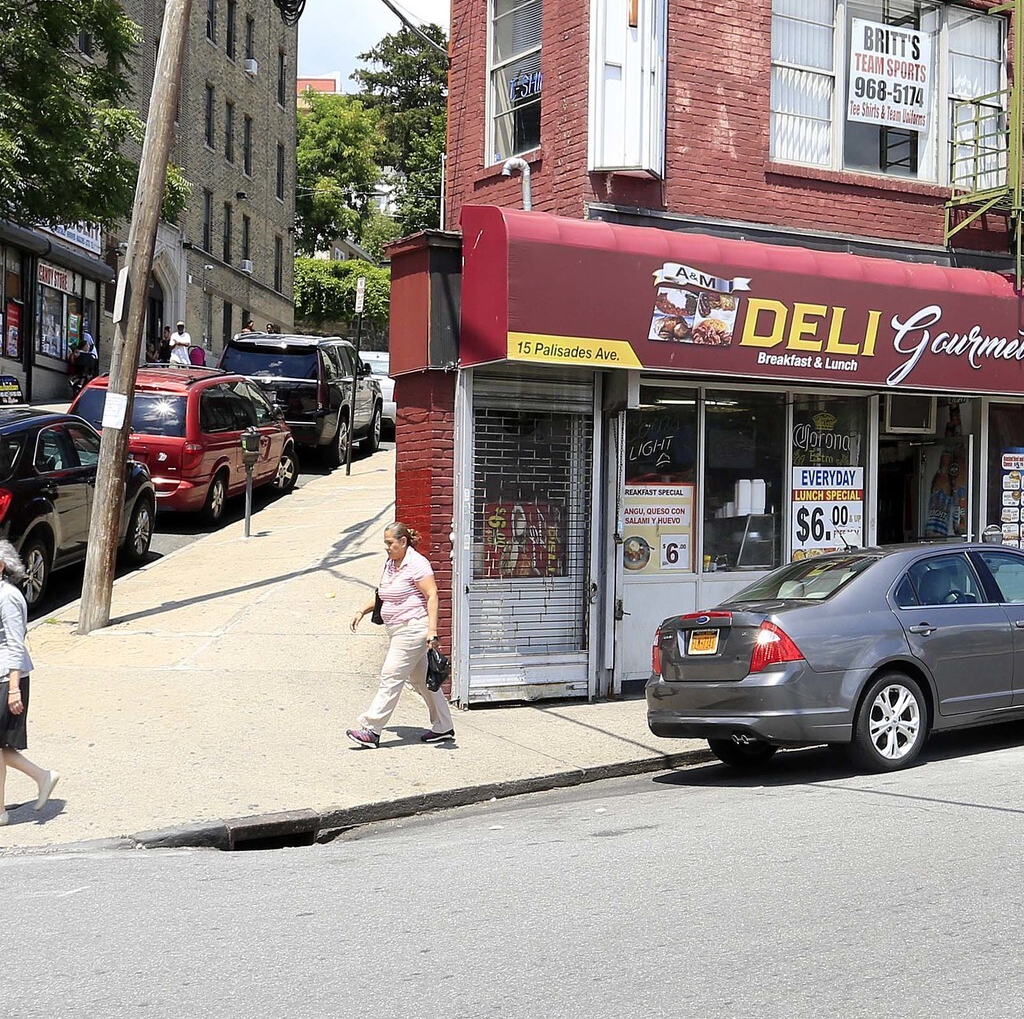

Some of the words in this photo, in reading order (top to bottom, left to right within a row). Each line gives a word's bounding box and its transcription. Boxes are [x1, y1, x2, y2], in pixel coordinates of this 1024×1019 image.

[864, 25, 920, 60] BRITT'S
[855, 53, 884, 75] TEAM
[887, 58, 926, 83] SPORTS
[855, 76, 924, 108] 968-5174
[850, 100, 860, 116] Tee
[862, 101, 879, 119] Shirts
[887, 106, 901, 121] Team
[675, 267, 716, 289] A&M
[739, 297, 882, 356] DELI
[517, 342, 531, 354] 15
[534, 343, 592, 359] Palisades
[595, 347, 620, 361] Ave.
[758, 352, 812, 368] Breakfast
[813, 356, 822, 369] &
[825, 357, 858, 371] Lunch
[630, 435, 674, 461] LIGHT
[801, 470, 856, 486] EVERYDAY
[795, 489, 824, 501] LUNCH
[826, 489, 861, 501] SPECIAL
[624, 507, 645, 516] ANGU,
[646, 507, 670, 515] QUESO
[671, 507, 686, 515] CON
